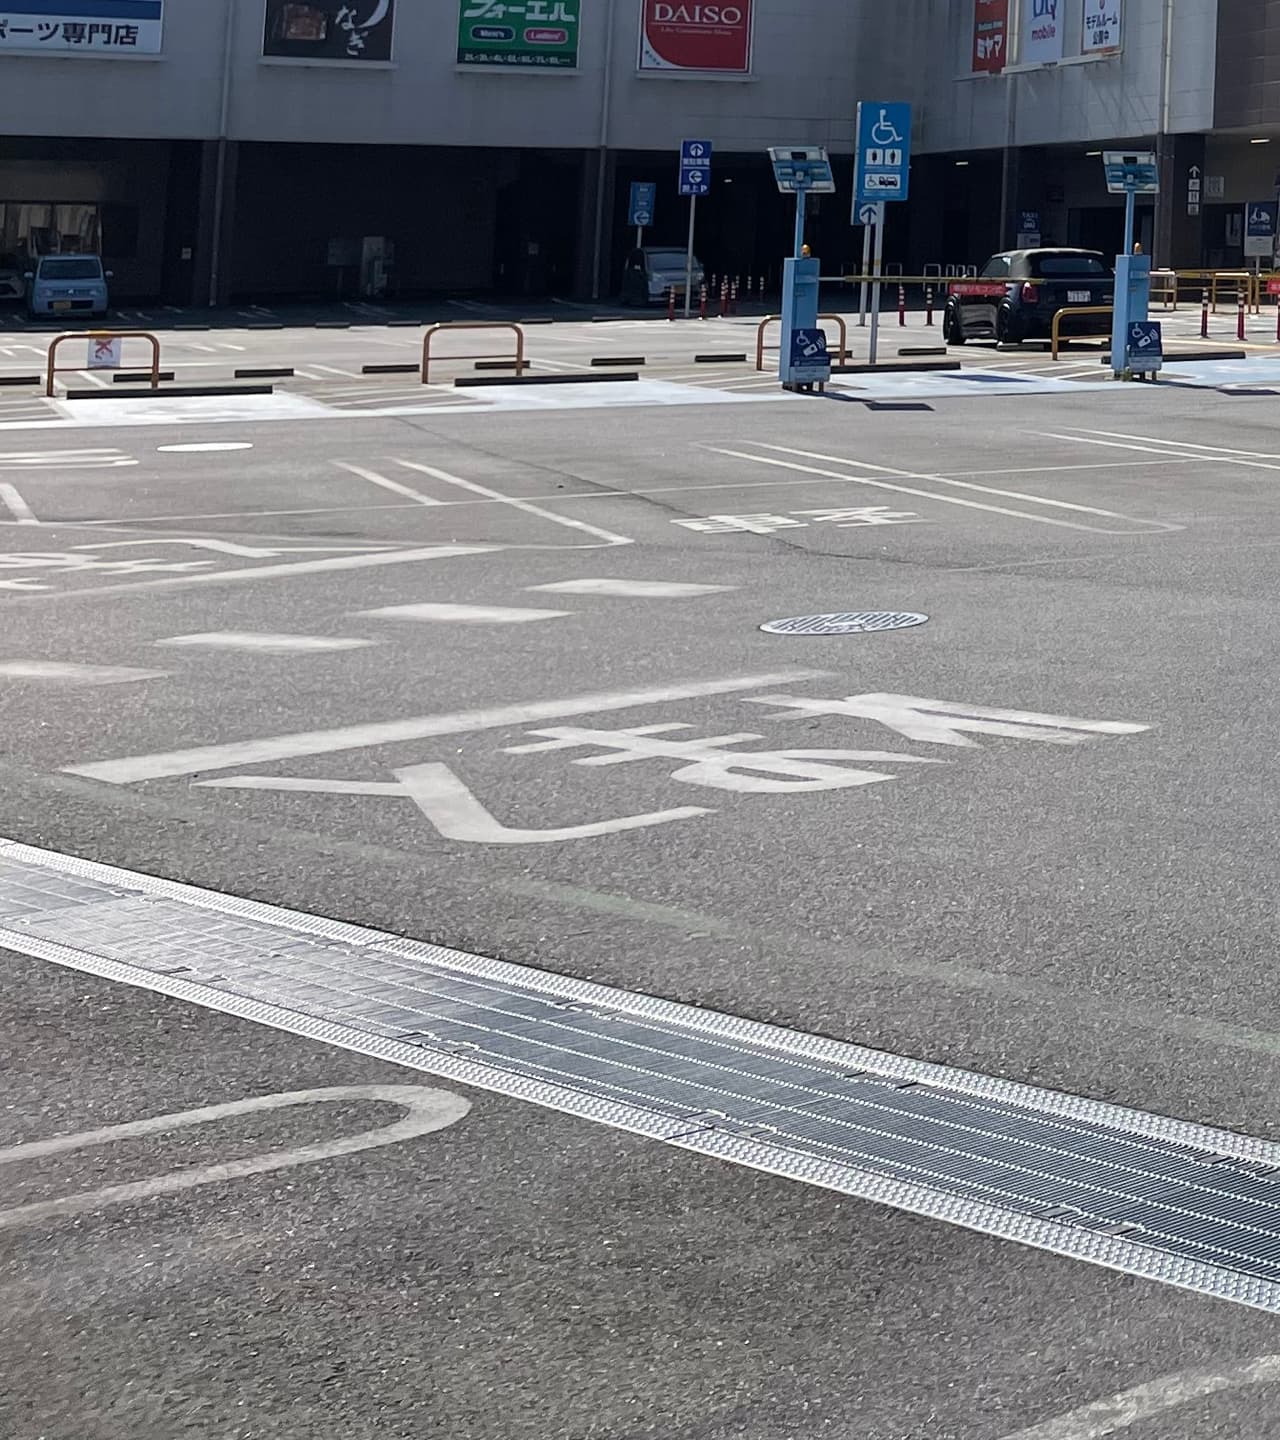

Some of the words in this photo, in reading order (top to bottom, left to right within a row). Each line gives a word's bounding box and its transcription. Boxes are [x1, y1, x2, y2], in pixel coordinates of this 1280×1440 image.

[654, 3, 742, 25] DAISO
[1031, 24, 1056, 40] mobile
[190, 691, 1154, 844] とまれ
